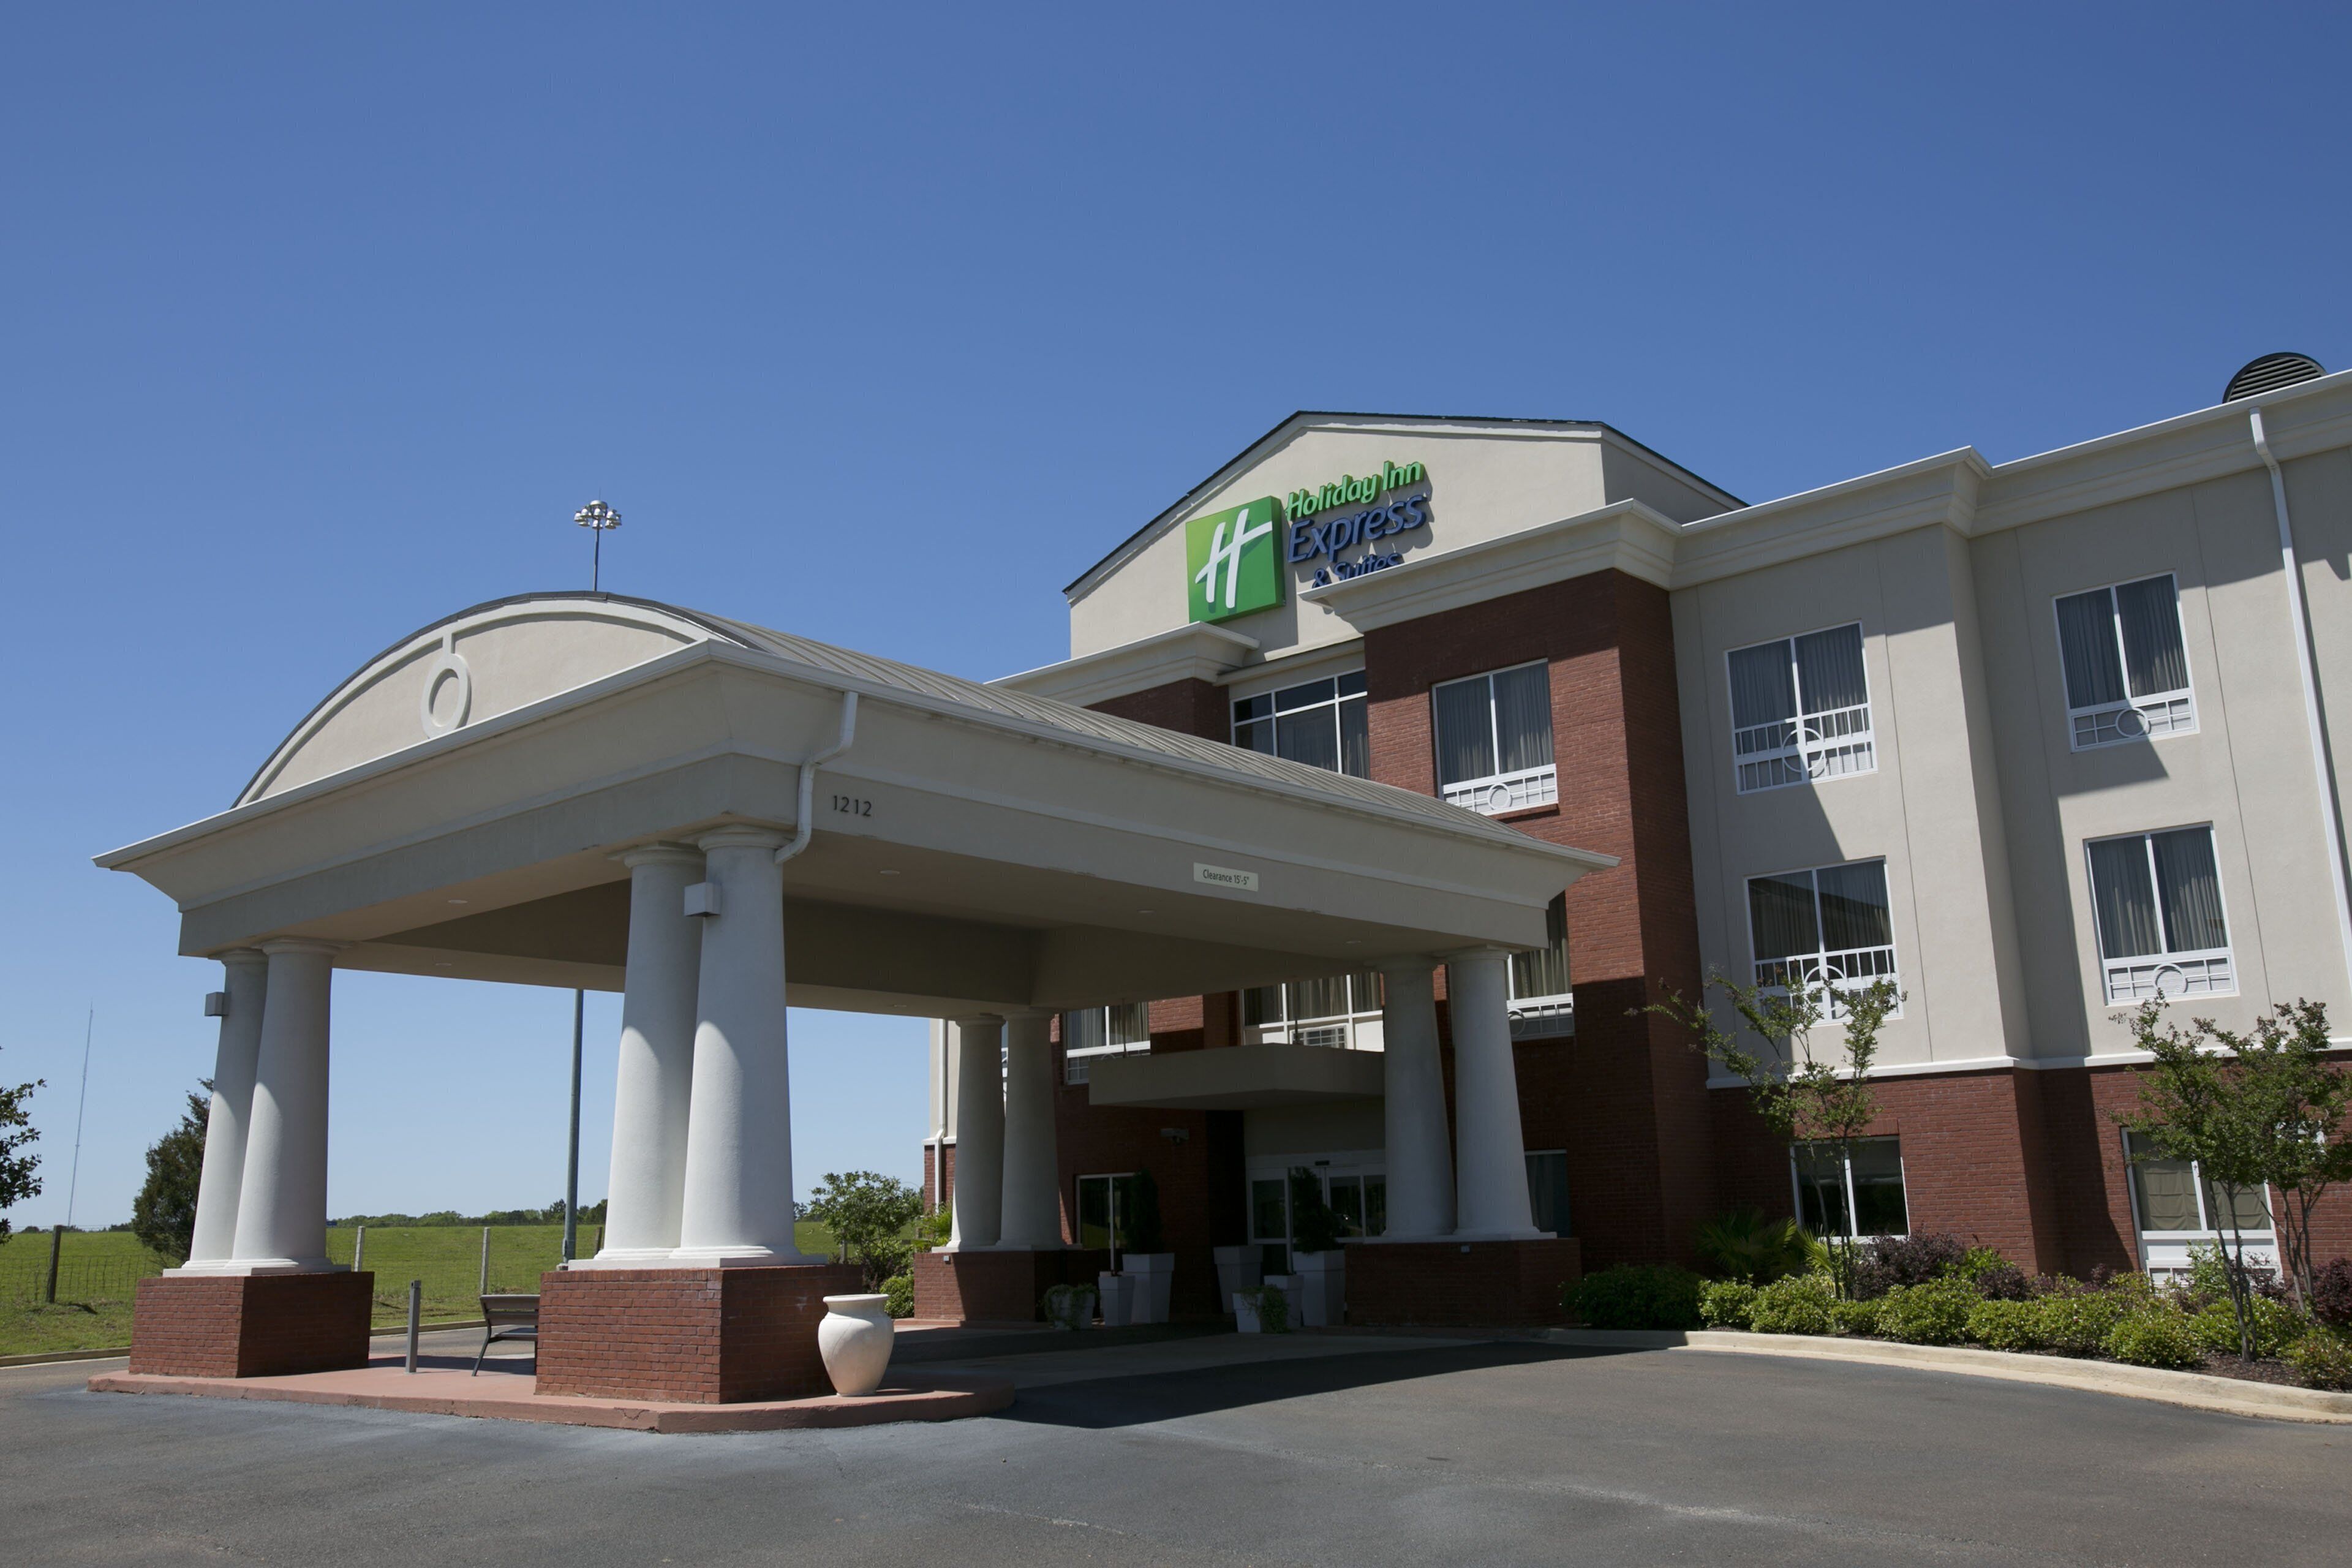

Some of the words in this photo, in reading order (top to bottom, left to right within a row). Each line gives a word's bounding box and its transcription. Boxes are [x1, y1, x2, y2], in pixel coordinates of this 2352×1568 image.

[1285, 473, 1381, 521] Holiday
[1382, 460, 1424, 491] Inn
[1288, 494, 1426, 563] Express
[833, 795, 872, 817] 1212
[1202, 869, 1233, 883] Clearance
